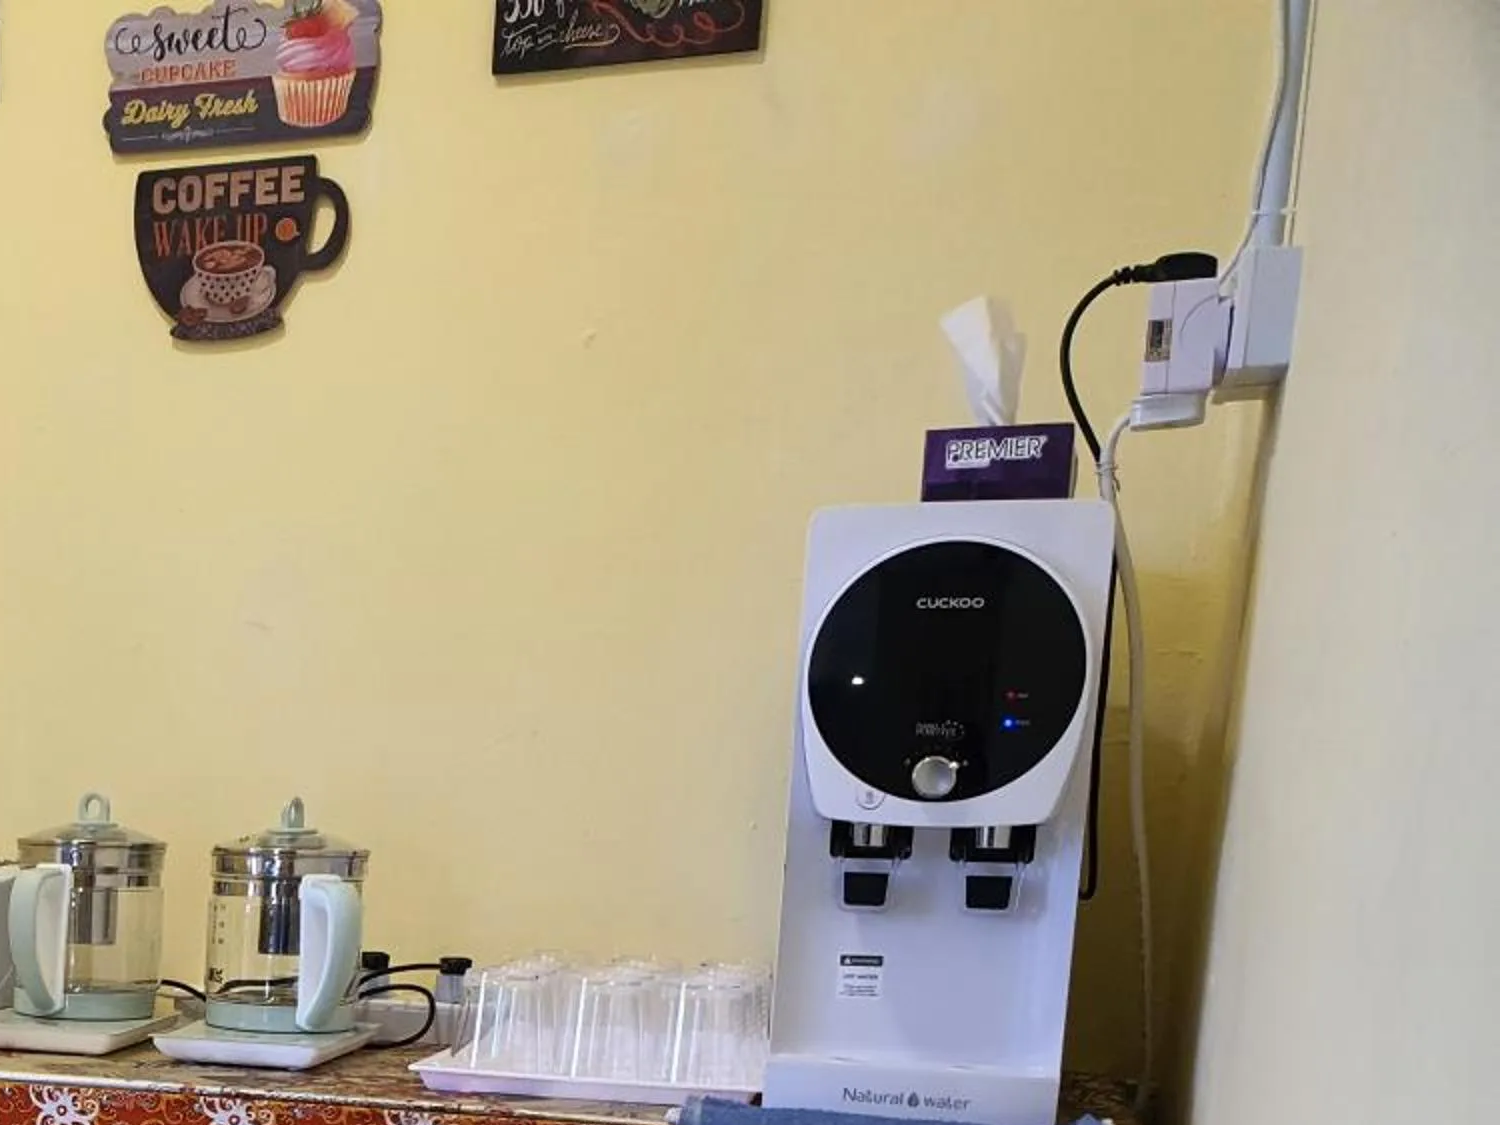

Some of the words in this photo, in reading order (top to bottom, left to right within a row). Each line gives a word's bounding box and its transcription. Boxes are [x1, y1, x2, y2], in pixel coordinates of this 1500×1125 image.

[141, 59, 236, 82] CUPCAKE
[121, 99, 190, 129] Dairy
[194, 89, 259, 119] Fresh
[152, 166, 305, 214] COFFEE
[153, 214, 227, 258] WAKE
[237, 212, 268, 246] UP
[947, 435, 1046, 462] PREMIER
[916, 597, 985, 609] CUCKOO
[843, 1087, 904, 1105] Natural
[923, 1096, 971, 1110] water
